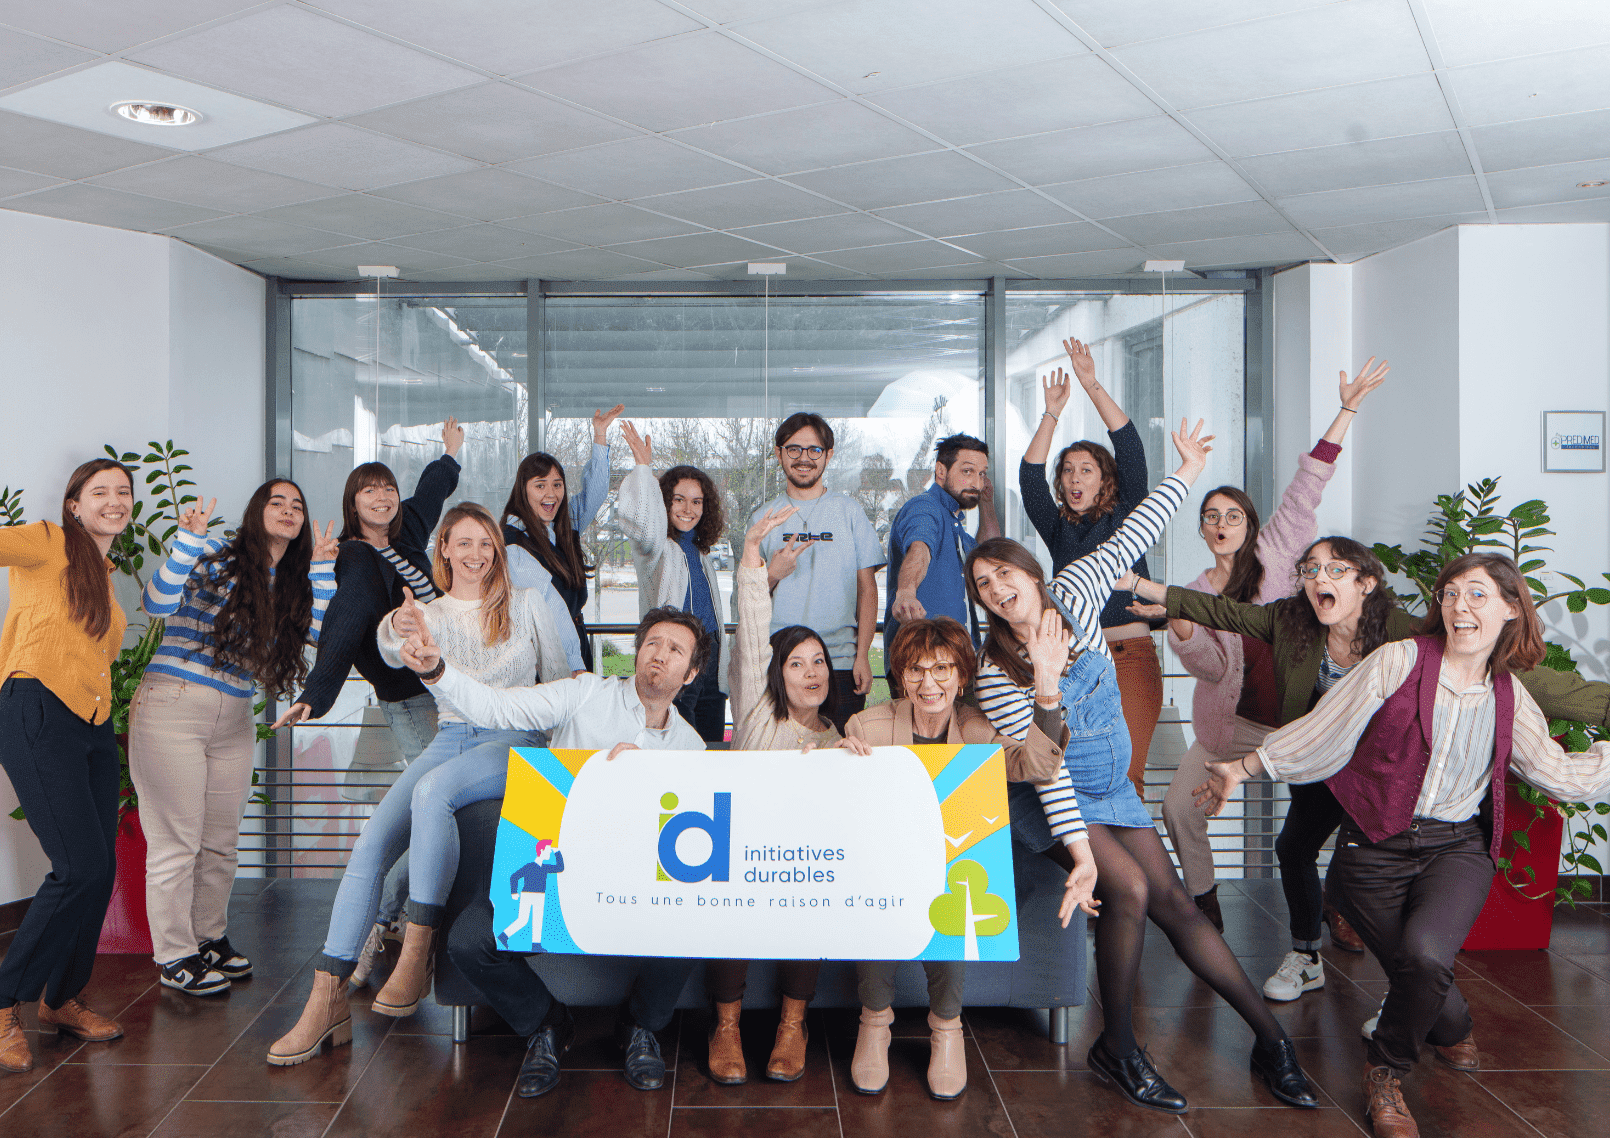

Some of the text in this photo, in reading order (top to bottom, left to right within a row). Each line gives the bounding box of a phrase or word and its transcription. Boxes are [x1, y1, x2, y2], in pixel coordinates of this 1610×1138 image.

[656, 791, 732, 884] id
[744, 844, 846, 862] initiatives
[743, 865, 836, 883] durables
[596, 891, 906, 910] Tous une bonne raison d'agir
